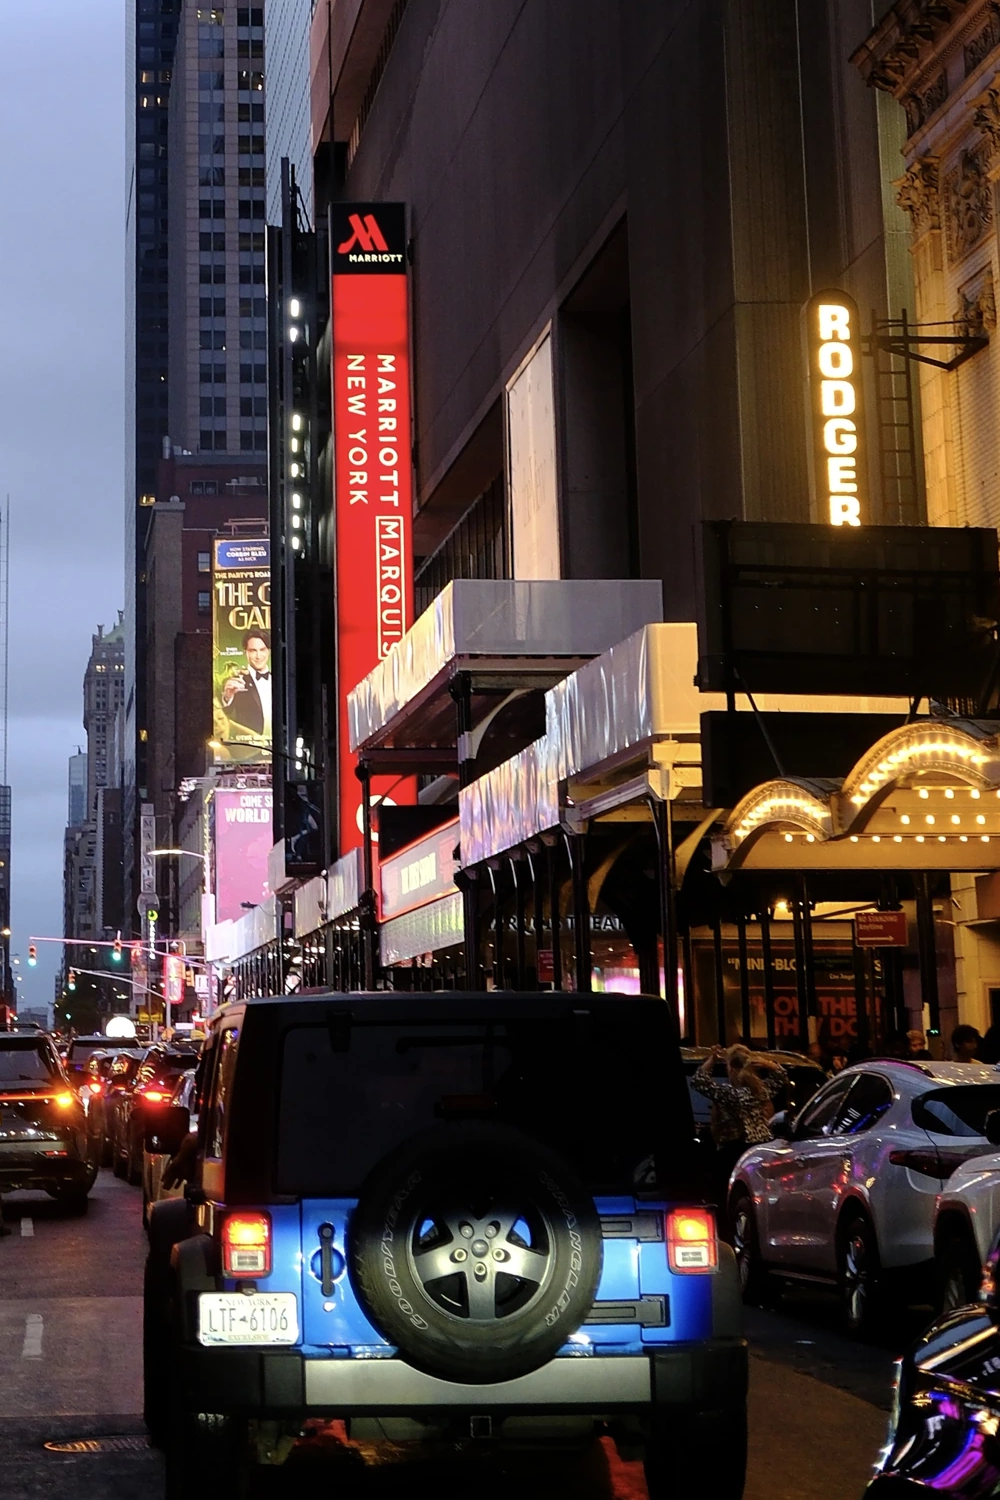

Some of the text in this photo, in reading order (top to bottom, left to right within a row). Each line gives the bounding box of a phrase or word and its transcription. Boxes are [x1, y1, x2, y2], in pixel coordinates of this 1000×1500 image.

[349, 254, 403, 263] MARRIOTT
[818, 304, 861, 527] RODGER
[346, 354, 368, 505] NEW YORK
[377, 354, 402, 657] MARRIOTT MARQUIS
[228, 571, 254, 579] PARTY'S
[215, 582, 253, 606] THE
[240, 795, 263, 807] COME
[225, 808, 270, 824] WORLD
